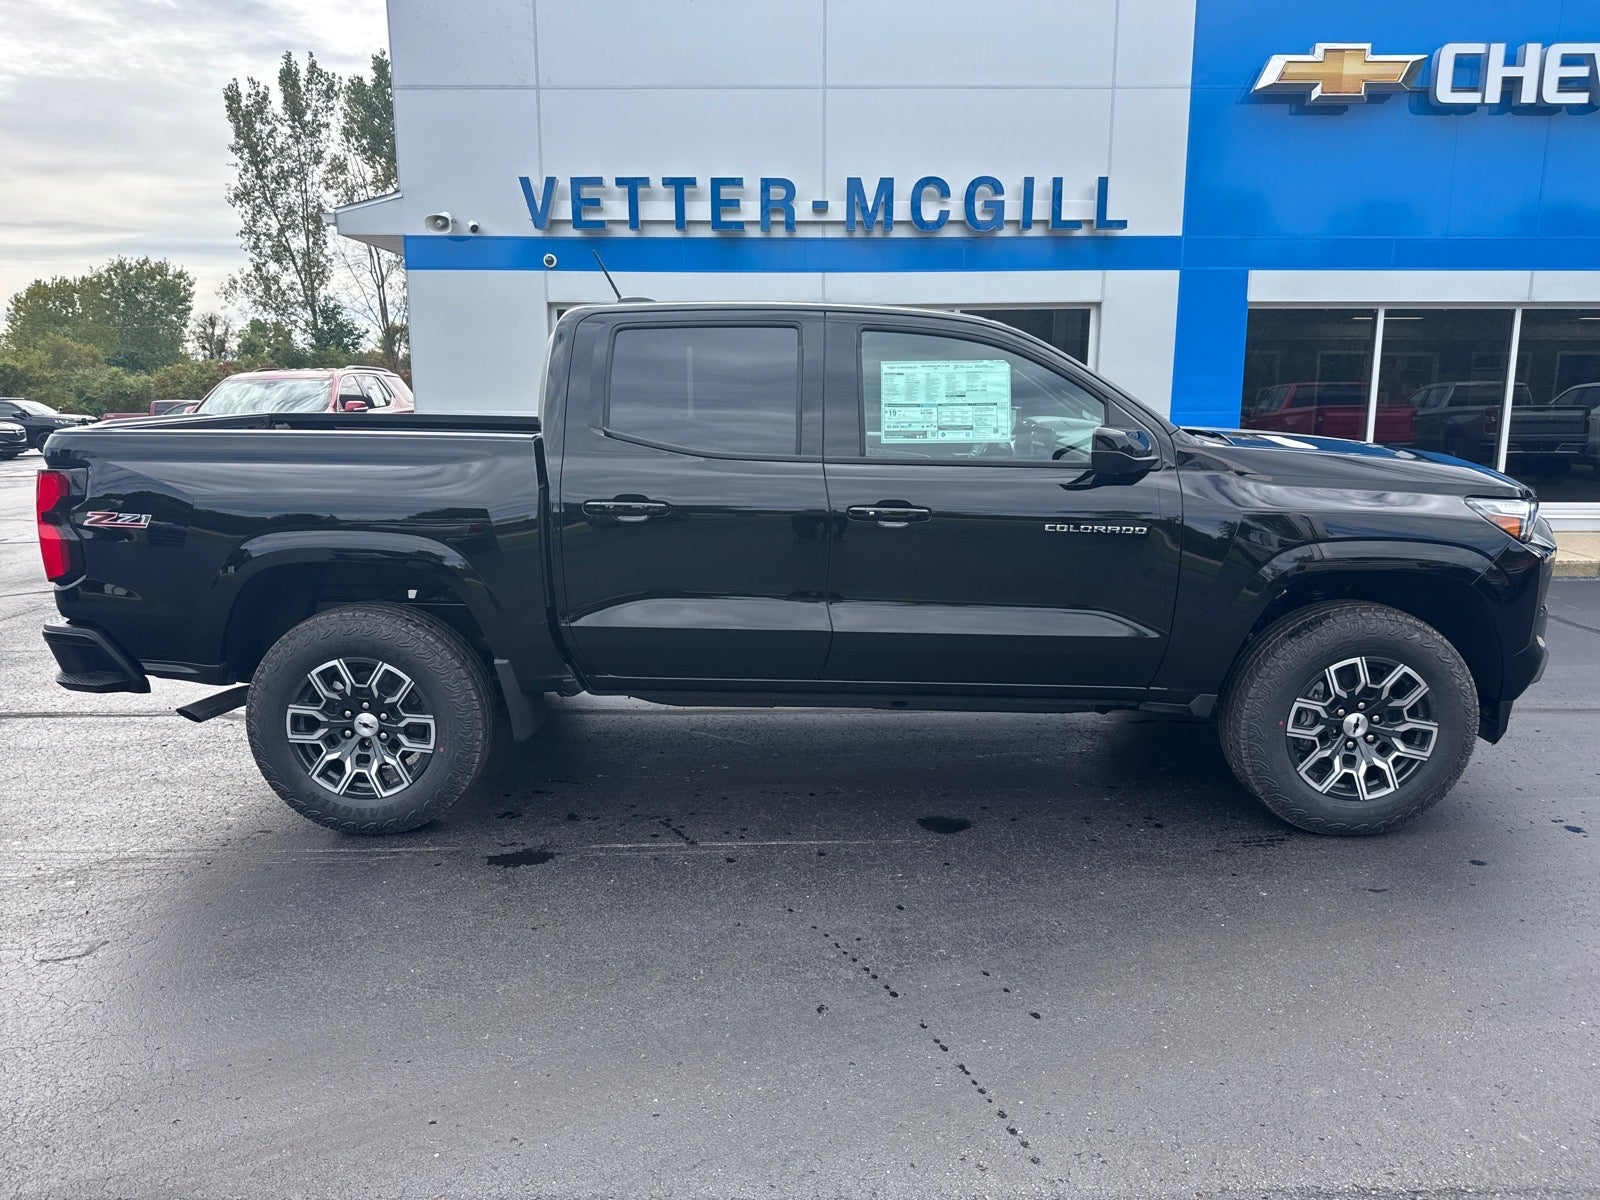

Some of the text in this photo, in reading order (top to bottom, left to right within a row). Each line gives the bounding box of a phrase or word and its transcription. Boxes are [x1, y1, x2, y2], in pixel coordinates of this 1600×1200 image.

[1433, 42, 1600, 104] CHE
[518, 175, 1128, 232] VETTER-MCGILL
[82, 511, 152, 529] Z71
[1044, 523, 1148, 534] COLORADO
